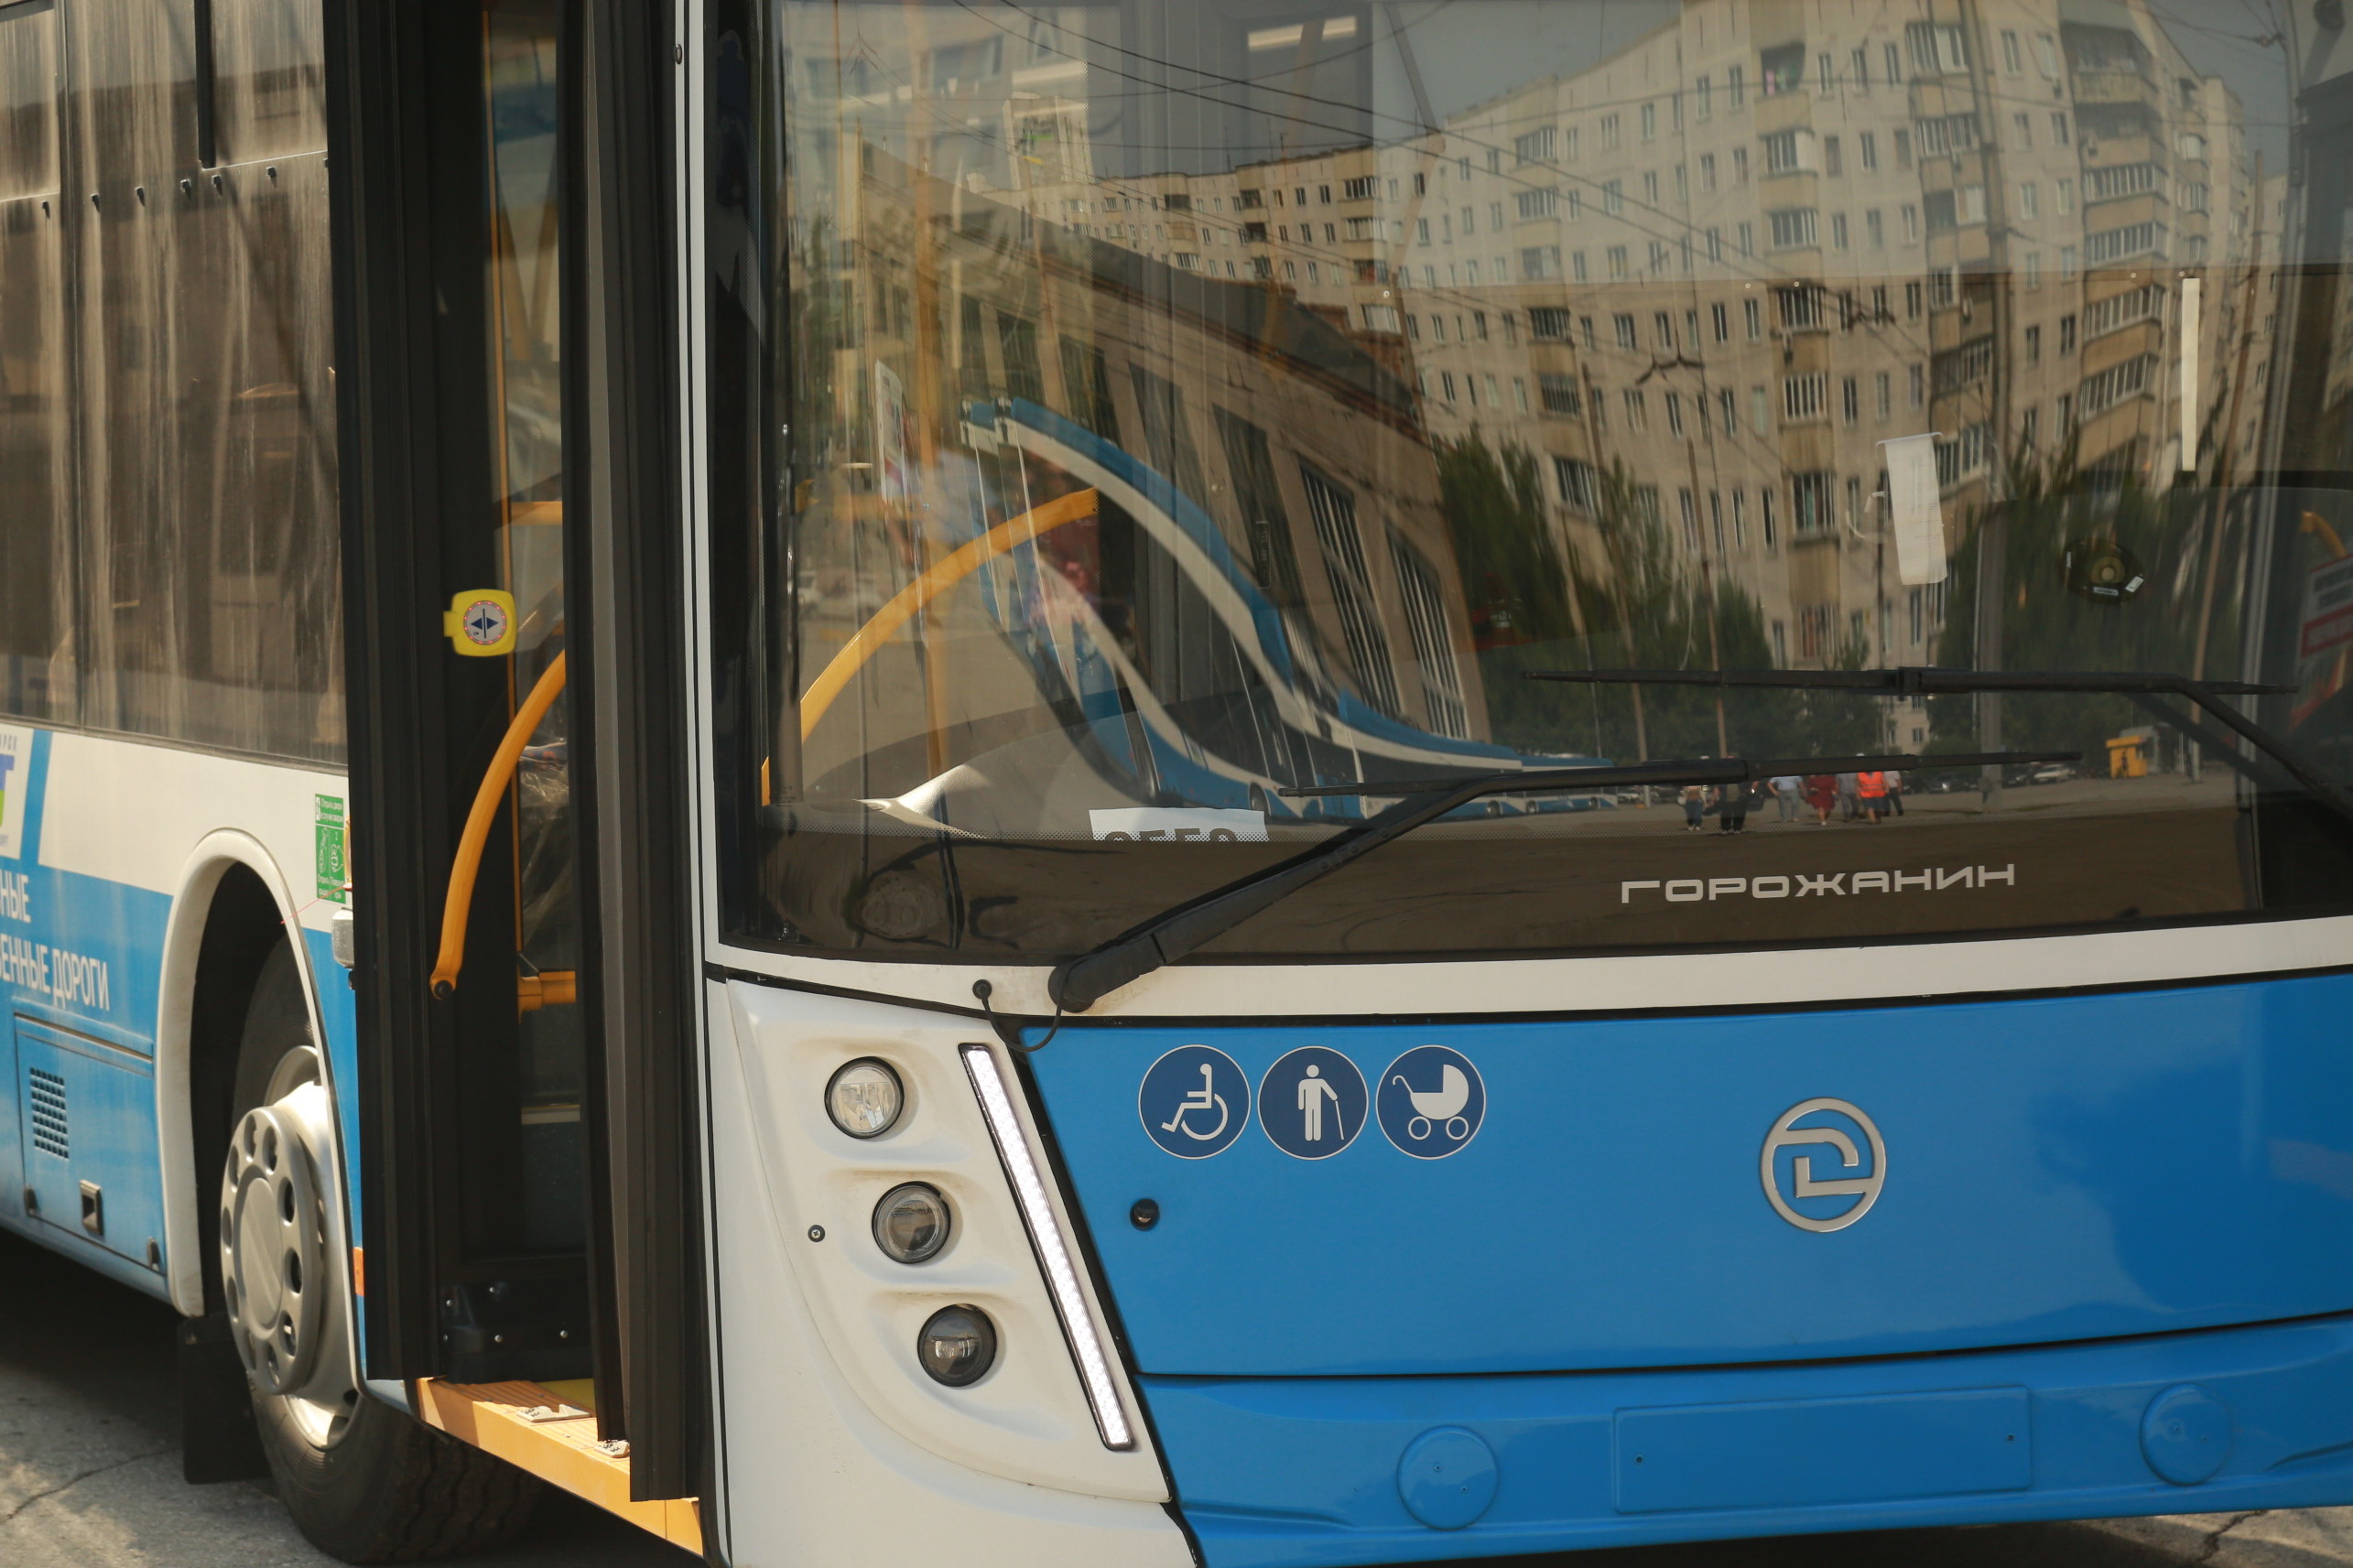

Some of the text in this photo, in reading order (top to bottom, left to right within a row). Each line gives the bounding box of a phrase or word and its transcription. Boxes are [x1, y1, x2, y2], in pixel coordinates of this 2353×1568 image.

[1621, 863, 2014, 903] ГОРОЖАНИН
[0, 933, 110, 1011] ЕННЫЕ ДОРОГИ
